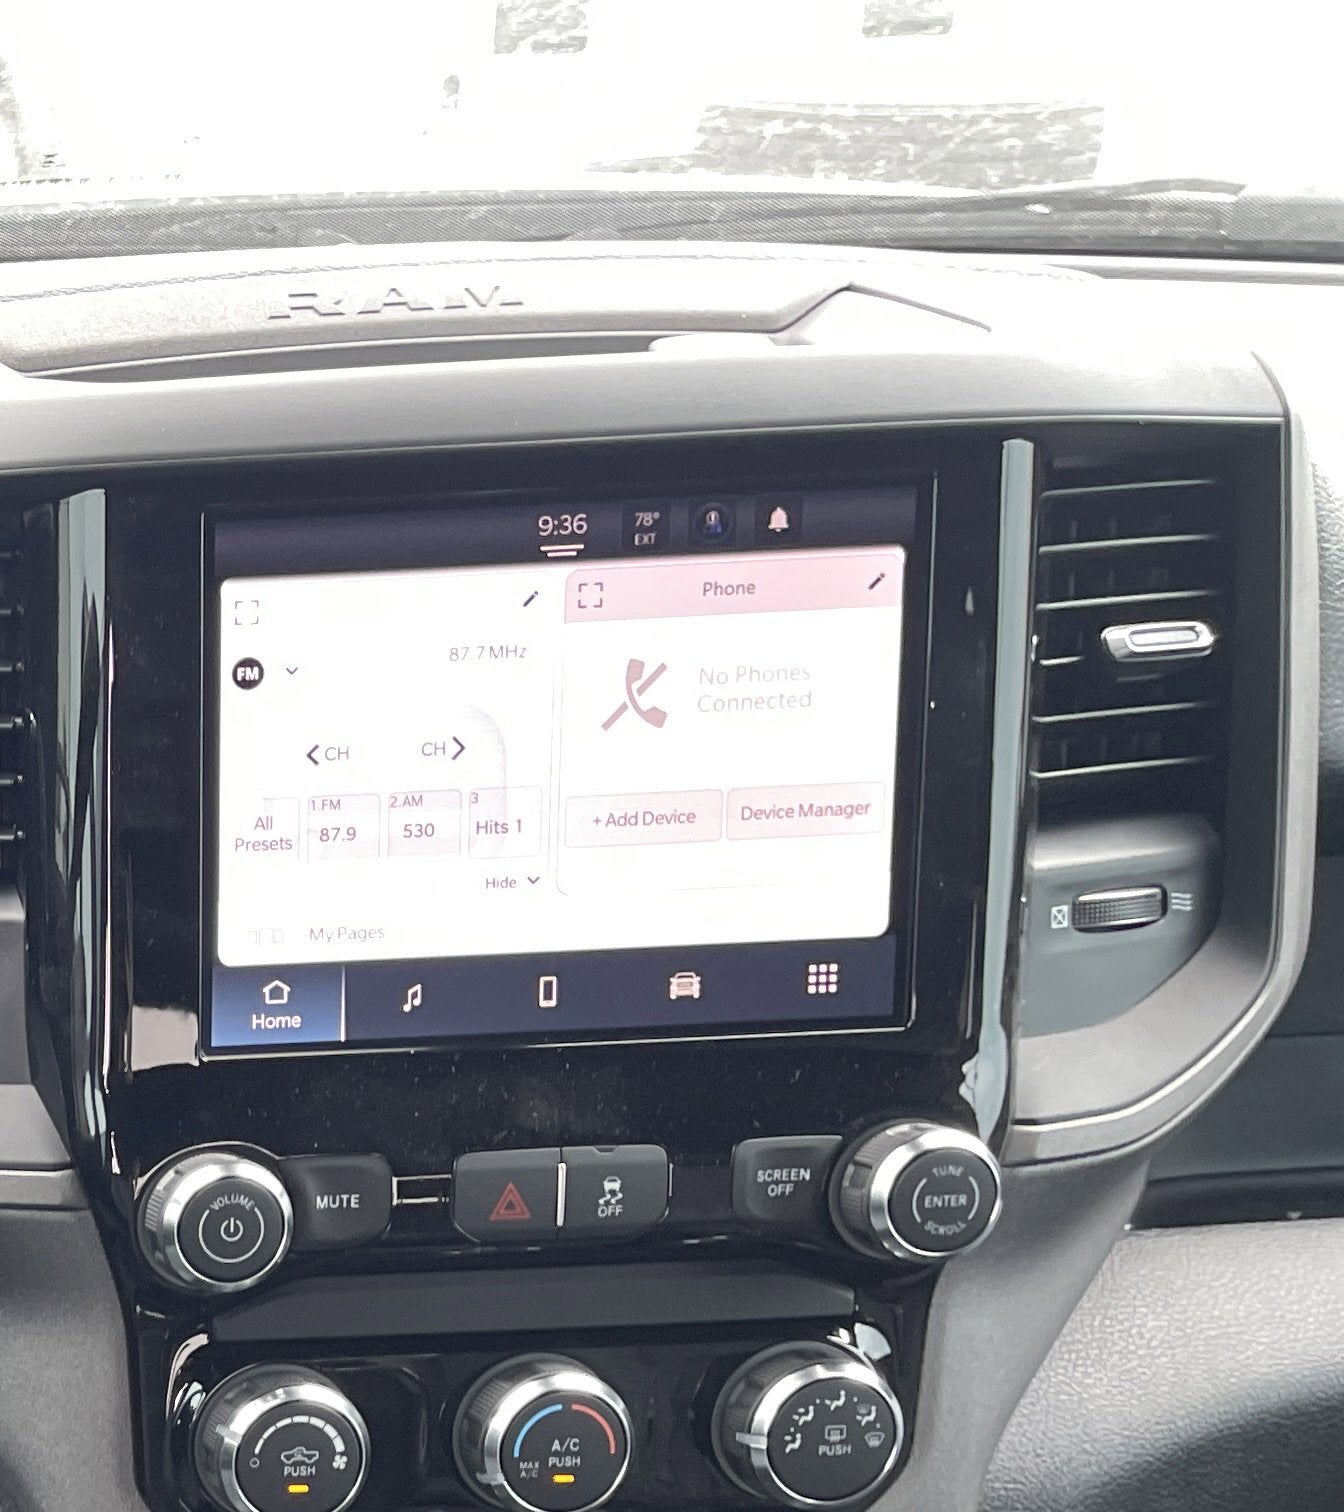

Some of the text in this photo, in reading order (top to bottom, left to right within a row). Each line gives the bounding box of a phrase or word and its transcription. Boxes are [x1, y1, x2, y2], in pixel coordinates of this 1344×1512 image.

[267, 285, 524, 320] RAM
[538, 513, 588, 537] 9:36
[702, 580, 757, 598] Phone
[489, 645, 526, 659] MHz
[236, 666, 259, 681] FM
[699, 665, 811, 685] No Phones
[697, 691, 812, 713] Connected
[324, 747, 350, 761] CH
[421, 742, 447, 757] CH
[471, 792, 480, 805] 3
[606, 812, 638, 827] Add
[642, 809, 697, 826] Device
[740, 802, 871, 822] Device Manager
[253, 815, 273, 831] All
[403, 823, 436, 838] 530
[475, 819, 523, 836] Hits 1
[319, 827, 357, 843] 87.9
[235, 837, 293, 853] Presets
[485, 877, 518, 890] Hide
[309, 926, 386, 944] My Pages
[252, 1012, 302, 1031] Home
[757, 1168, 811, 1183] SCREEN
[932, 1164, 965, 1178] TUNE
[767, 1183, 795, 1198] OFF
[210, 1193, 256, 1212] VOLUME
[315, 1193, 360, 1210] MUTE
[924, 1193, 968, 1209] ENTER
[597, 1204, 624, 1217] OFF
[924, 1219, 968, 1236] SCROLL
[551, 1437, 580, 1452] A/C
[818, 1443, 852, 1456] PUSH
[519, 1460, 540, 1469] MAX
[548, 1456, 581, 1468] PUSH
[283, 1464, 317, 1477] PUSH
